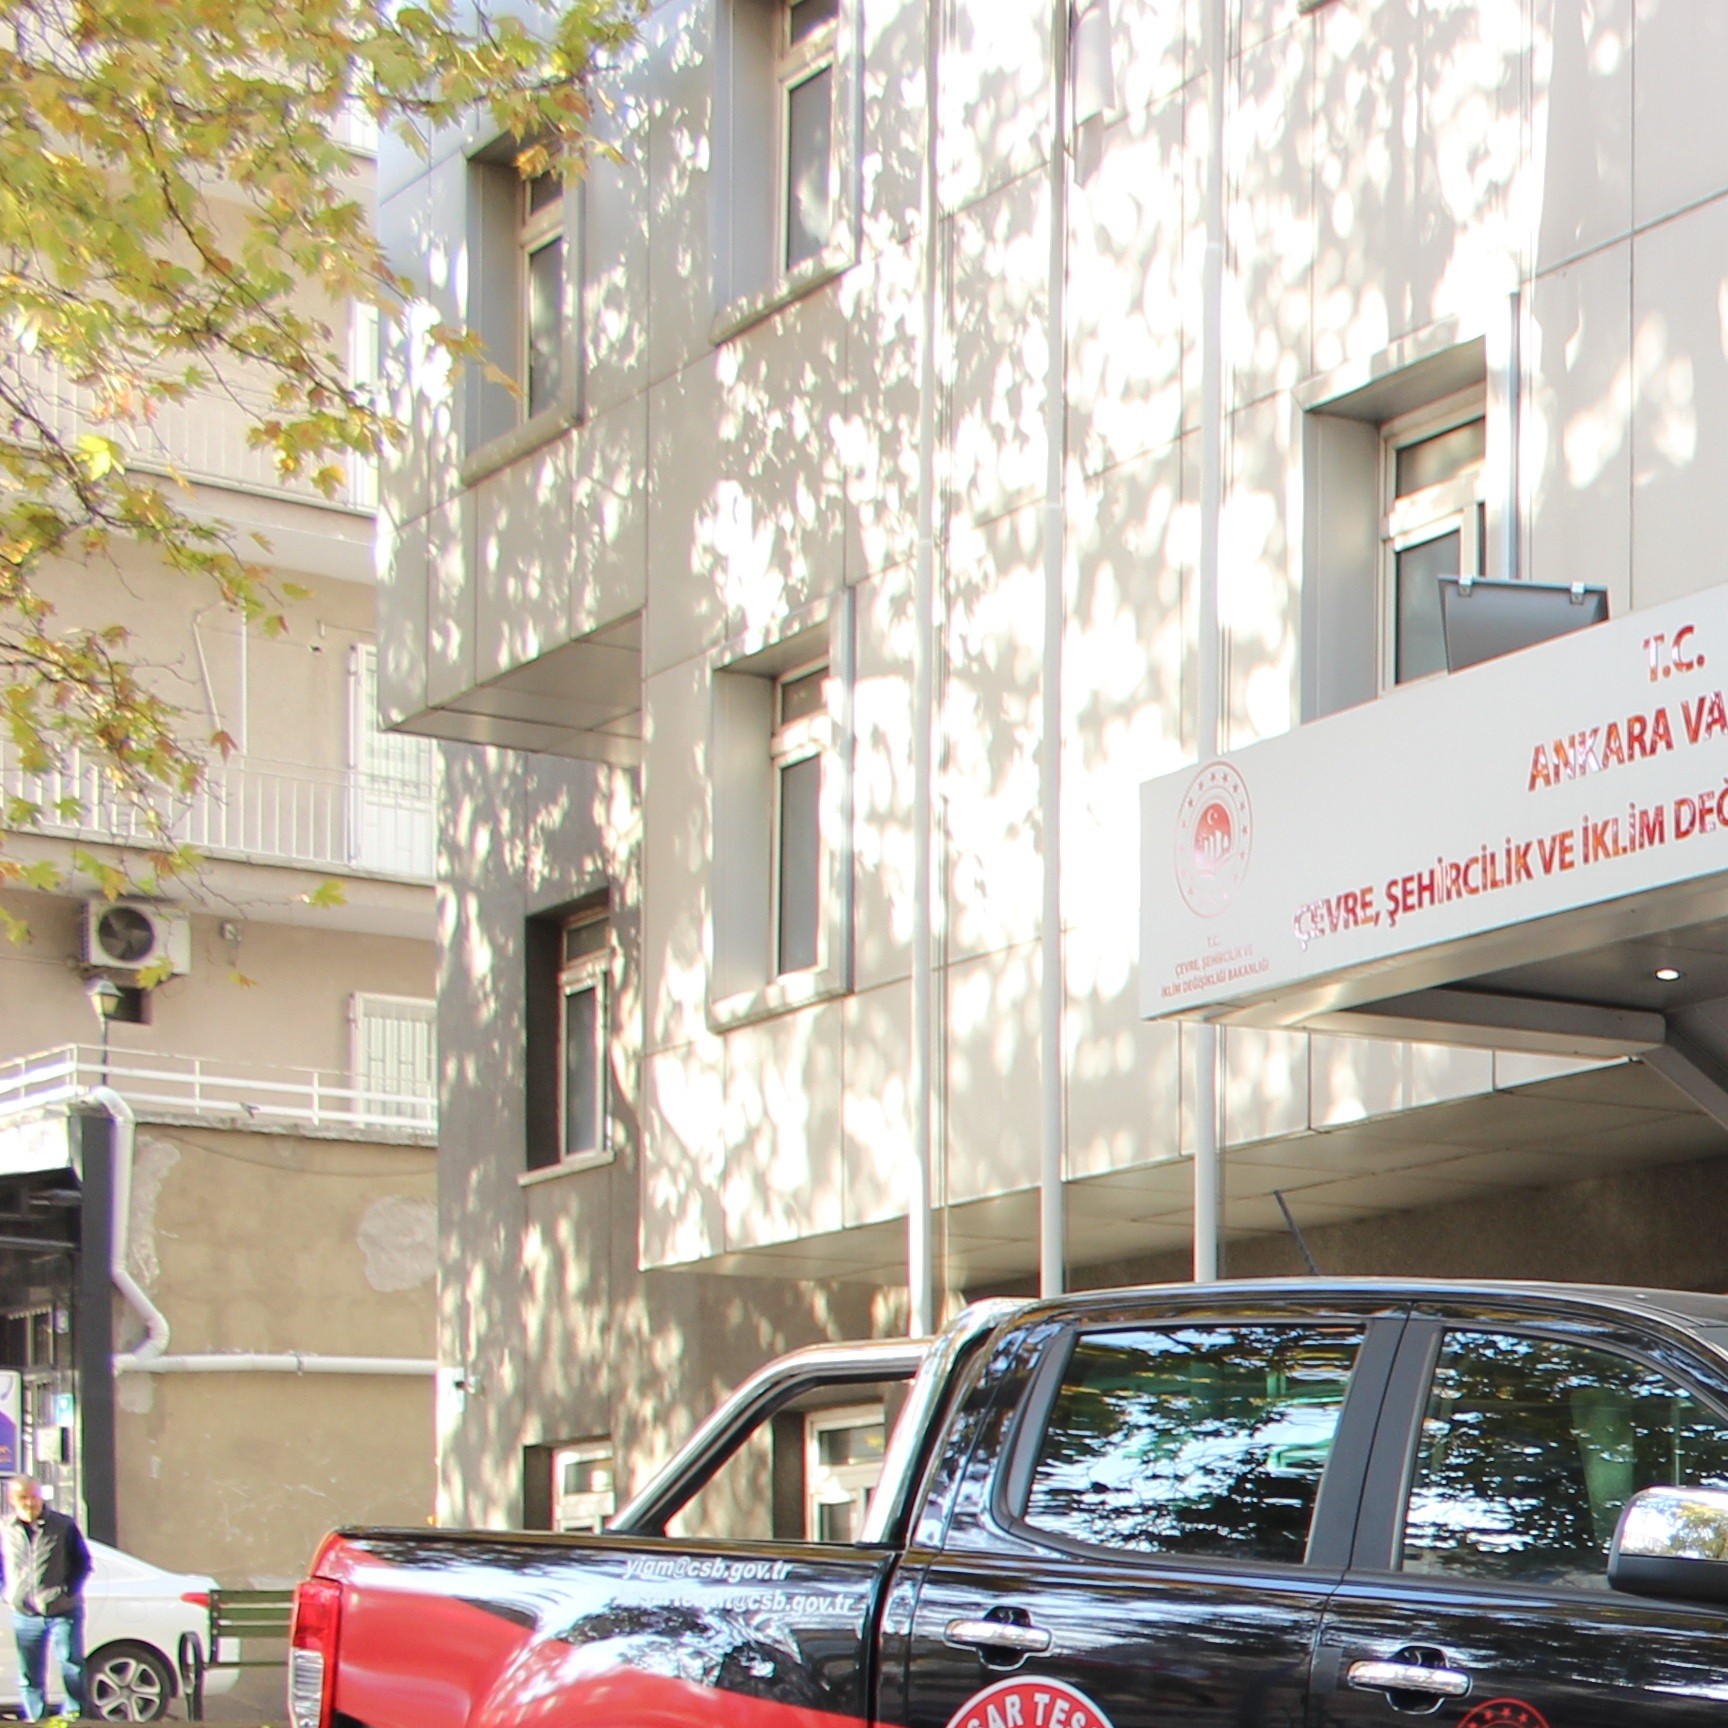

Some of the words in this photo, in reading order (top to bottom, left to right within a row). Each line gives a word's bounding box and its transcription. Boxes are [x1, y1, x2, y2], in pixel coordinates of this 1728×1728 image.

[1643, 624, 1706, 683] T.C.
[1528, 703, 1674, 792] ANKARA
[1293, 886, 1382, 951] ÇEVRE,
[1384, 835, 1535, 928] ŞEHİRCİLİK
[1538, 828, 1576, 876] VE
[1581, 801, 1666, 866] İKLİM
